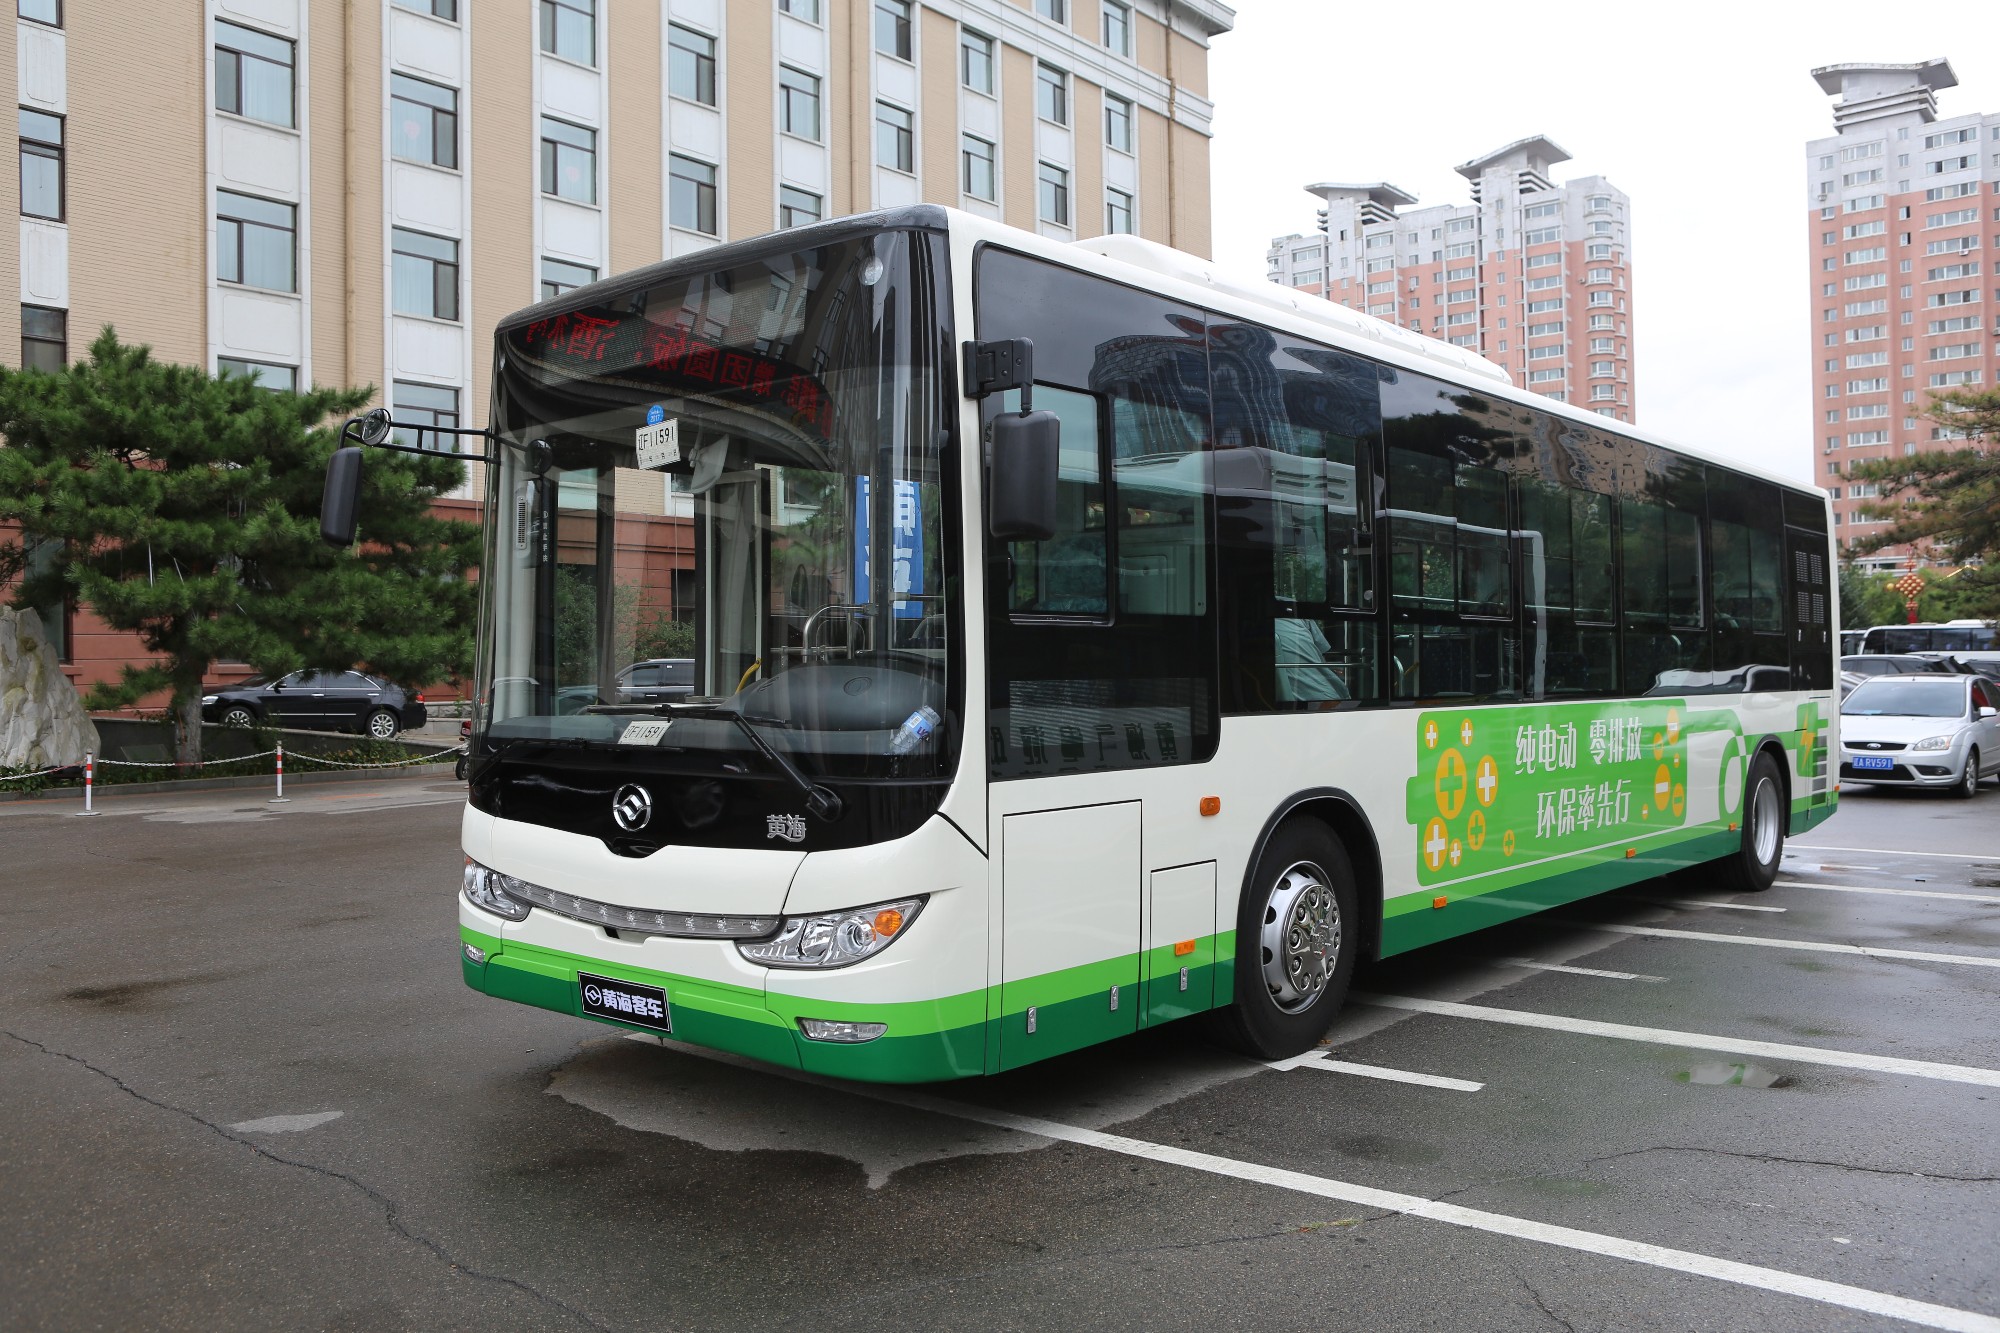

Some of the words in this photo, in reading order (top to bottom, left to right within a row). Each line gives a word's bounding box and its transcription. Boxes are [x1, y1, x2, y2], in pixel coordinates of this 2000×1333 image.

[1515, 722, 1577, 775] 纯电动
[1589, 717, 1643, 765] 零排放
[766, 813, 807, 842] 黄海
[1535, 779, 1632, 839] 环保率先行
[601, 988, 664, 1019] 黄海客车
